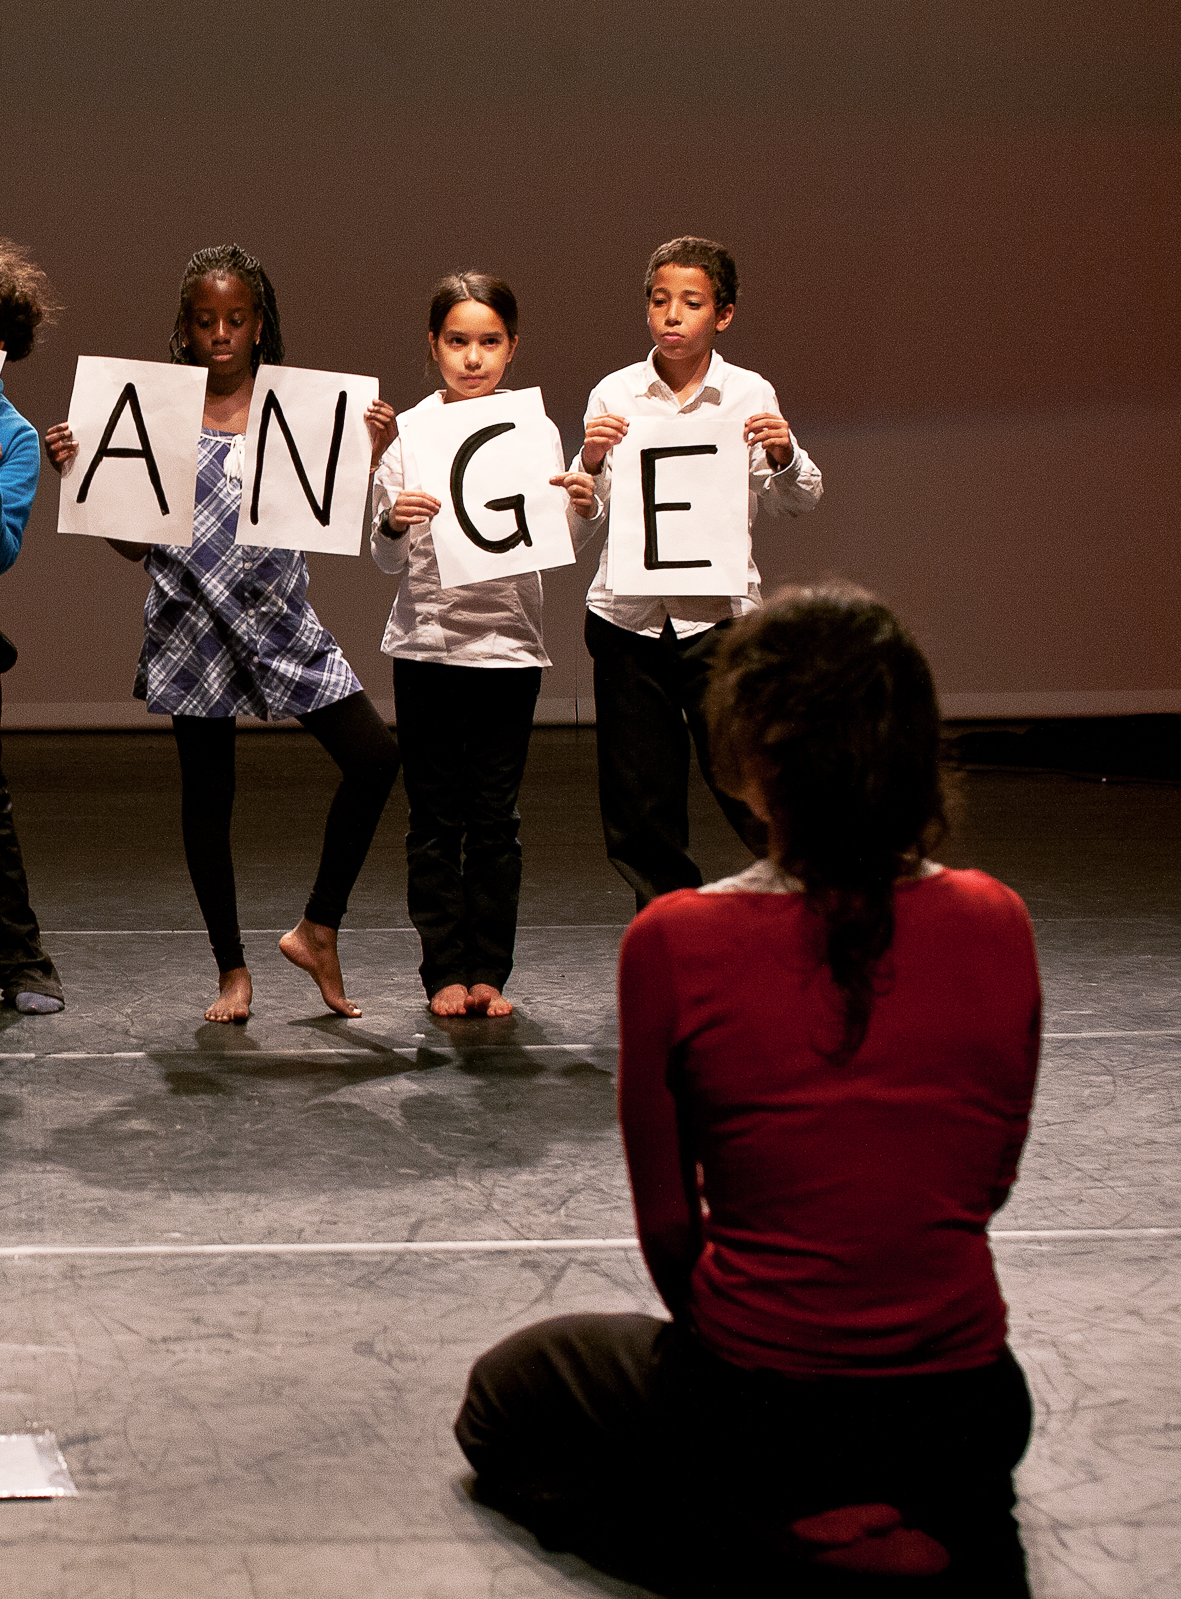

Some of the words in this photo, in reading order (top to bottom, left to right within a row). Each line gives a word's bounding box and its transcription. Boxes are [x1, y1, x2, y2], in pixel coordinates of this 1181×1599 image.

[75, 382, 170, 517] A
[249, 388, 348, 527] N
[449, 422, 533, 554] G
[640, 444, 718, 571] E
